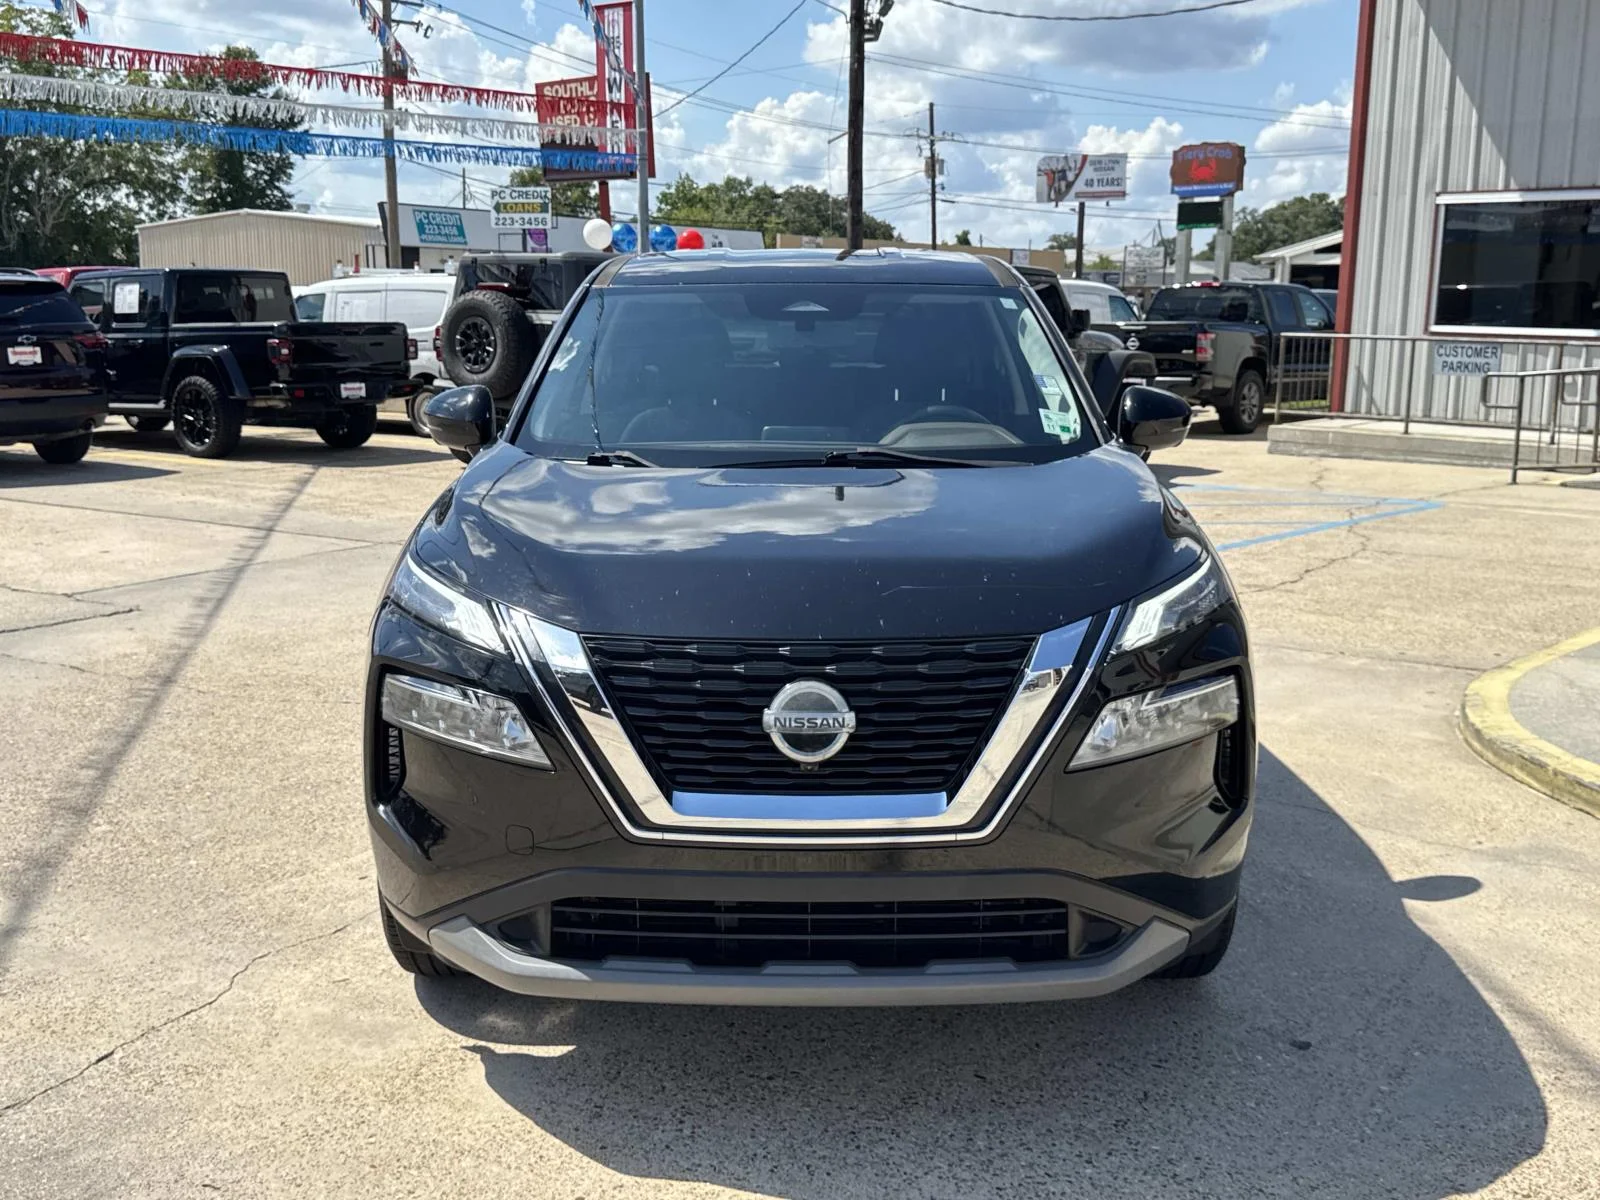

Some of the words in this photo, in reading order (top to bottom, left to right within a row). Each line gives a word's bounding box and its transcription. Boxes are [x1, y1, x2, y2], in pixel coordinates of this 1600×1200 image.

[1084, 178, 1094, 188] 40
[491, 190, 506, 200] PC
[510, 190, 549, 200] CREDIT
[500, 203, 541, 212] LOANS
[414, 211, 428, 224] PC
[429, 212, 461, 226] CREDIT
[494, 217, 547, 226] 223-3456
[1436, 344, 1499, 359] CUSTOMER
[1441, 361, 1491, 374] PARKING
[773, 717, 845, 729] NISSAN
